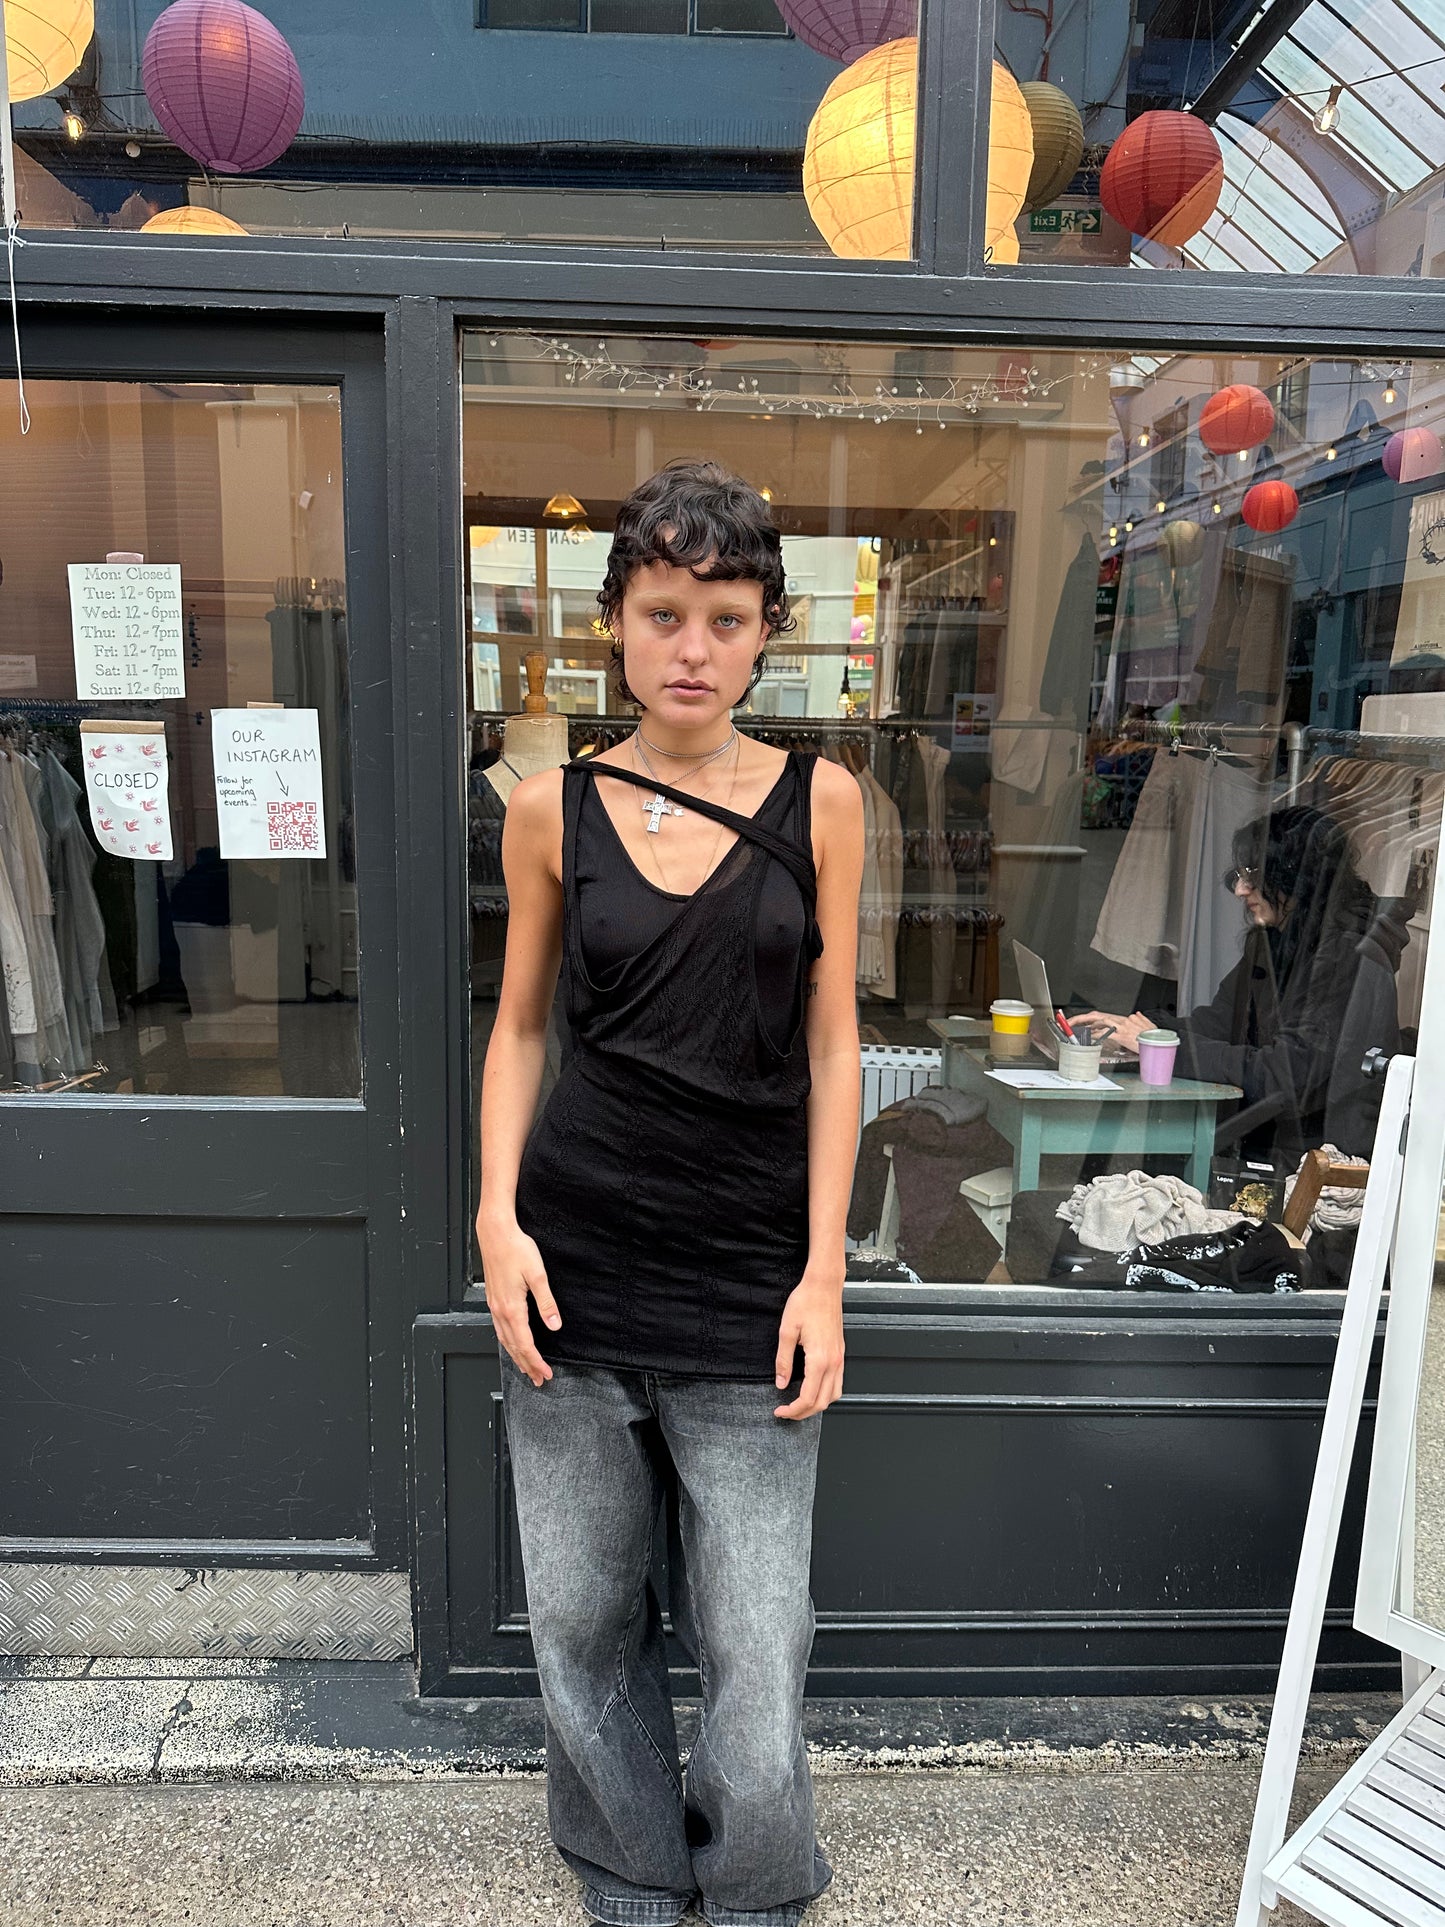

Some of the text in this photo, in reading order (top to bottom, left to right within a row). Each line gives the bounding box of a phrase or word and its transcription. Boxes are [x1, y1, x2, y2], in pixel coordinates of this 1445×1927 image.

[85, 567, 172, 580] Mon: Closed
[83, 586, 116, 599] Tue:
[82, 606, 121, 619] Wed:
[80, 625, 116, 638] Thu:
[94, 644, 118, 657] Fri:
[95, 664, 121, 676] Sat:
[90, 683, 122, 695] Sun:
[232, 729, 265, 743] OUR
[227, 748, 317, 763] INSTAGRAM
[94, 772, 159, 790] CLOSED
[217, 775, 253, 790] Follow for
[219, 789, 257, 801] upcoming
